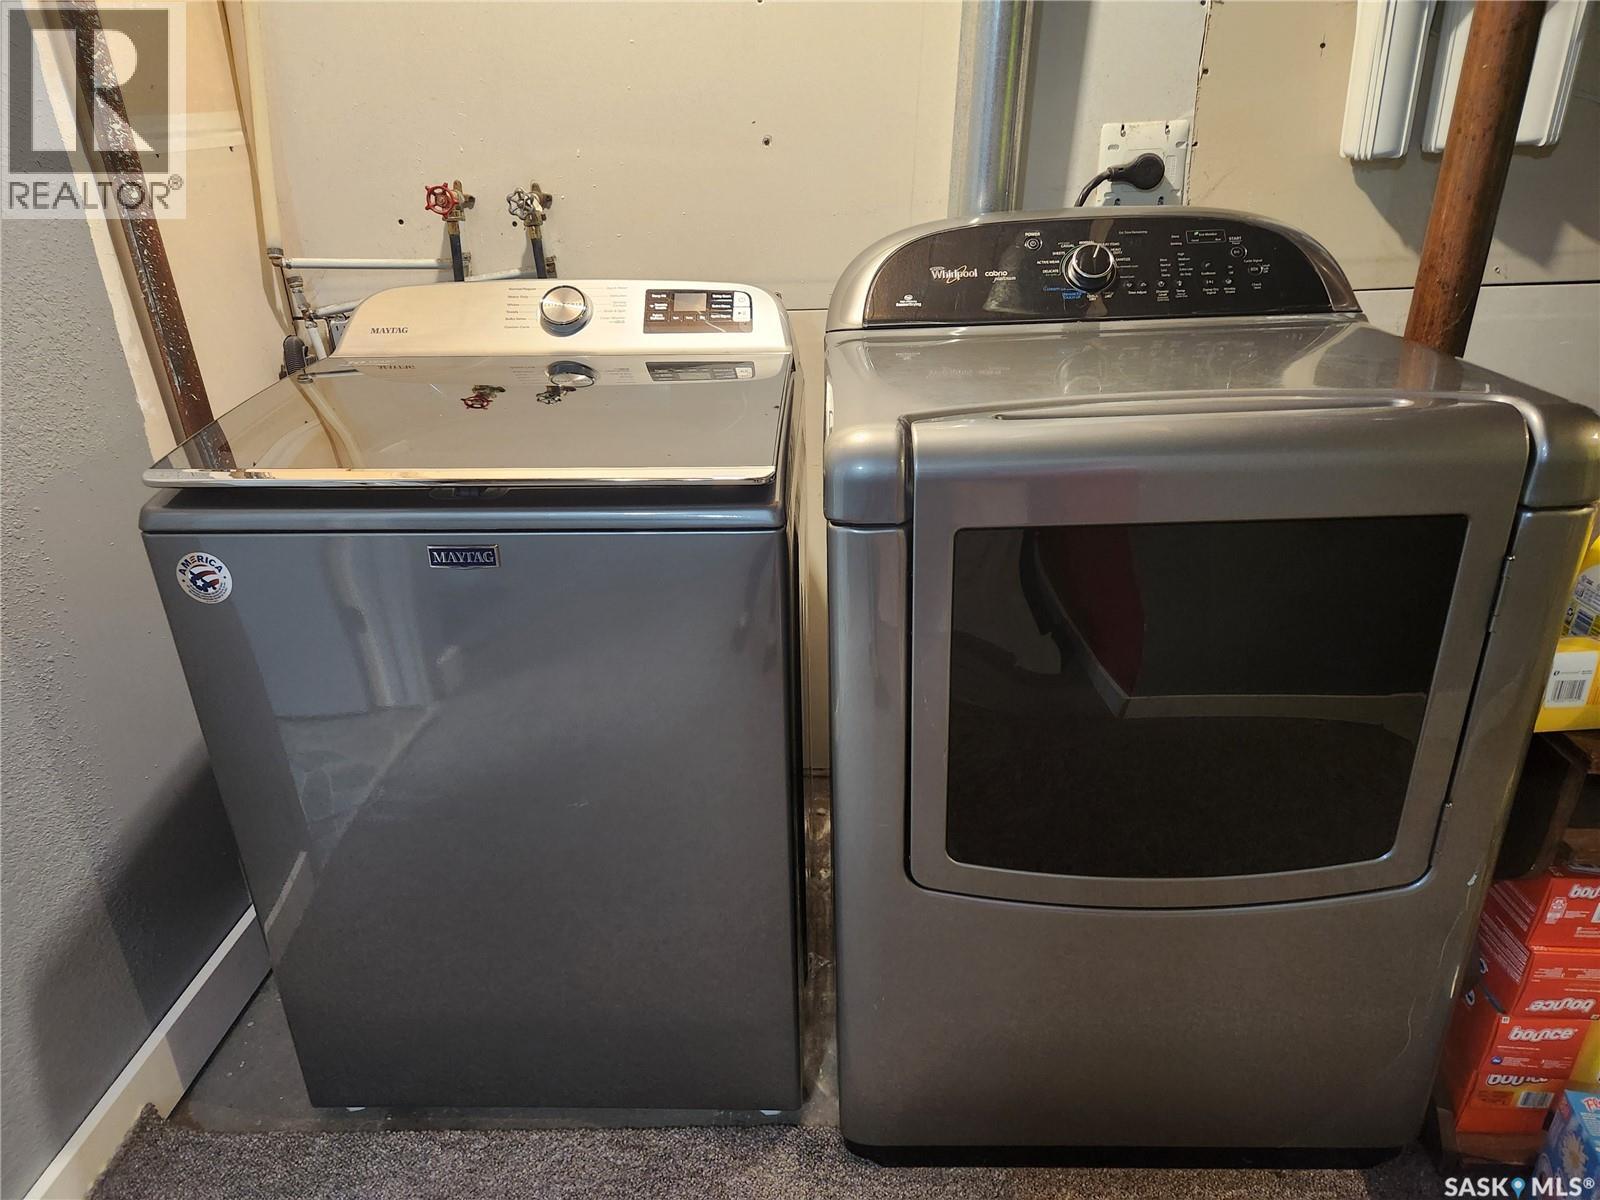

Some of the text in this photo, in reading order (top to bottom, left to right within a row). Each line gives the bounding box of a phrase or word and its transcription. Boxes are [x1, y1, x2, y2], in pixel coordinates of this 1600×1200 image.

[930, 268, 978, 281] Whirlpool
[432, 551, 494, 563] MAYTAG
[178, 555, 223, 576] AMERICA
[1508, 1025, 1575, 1042] bounce
